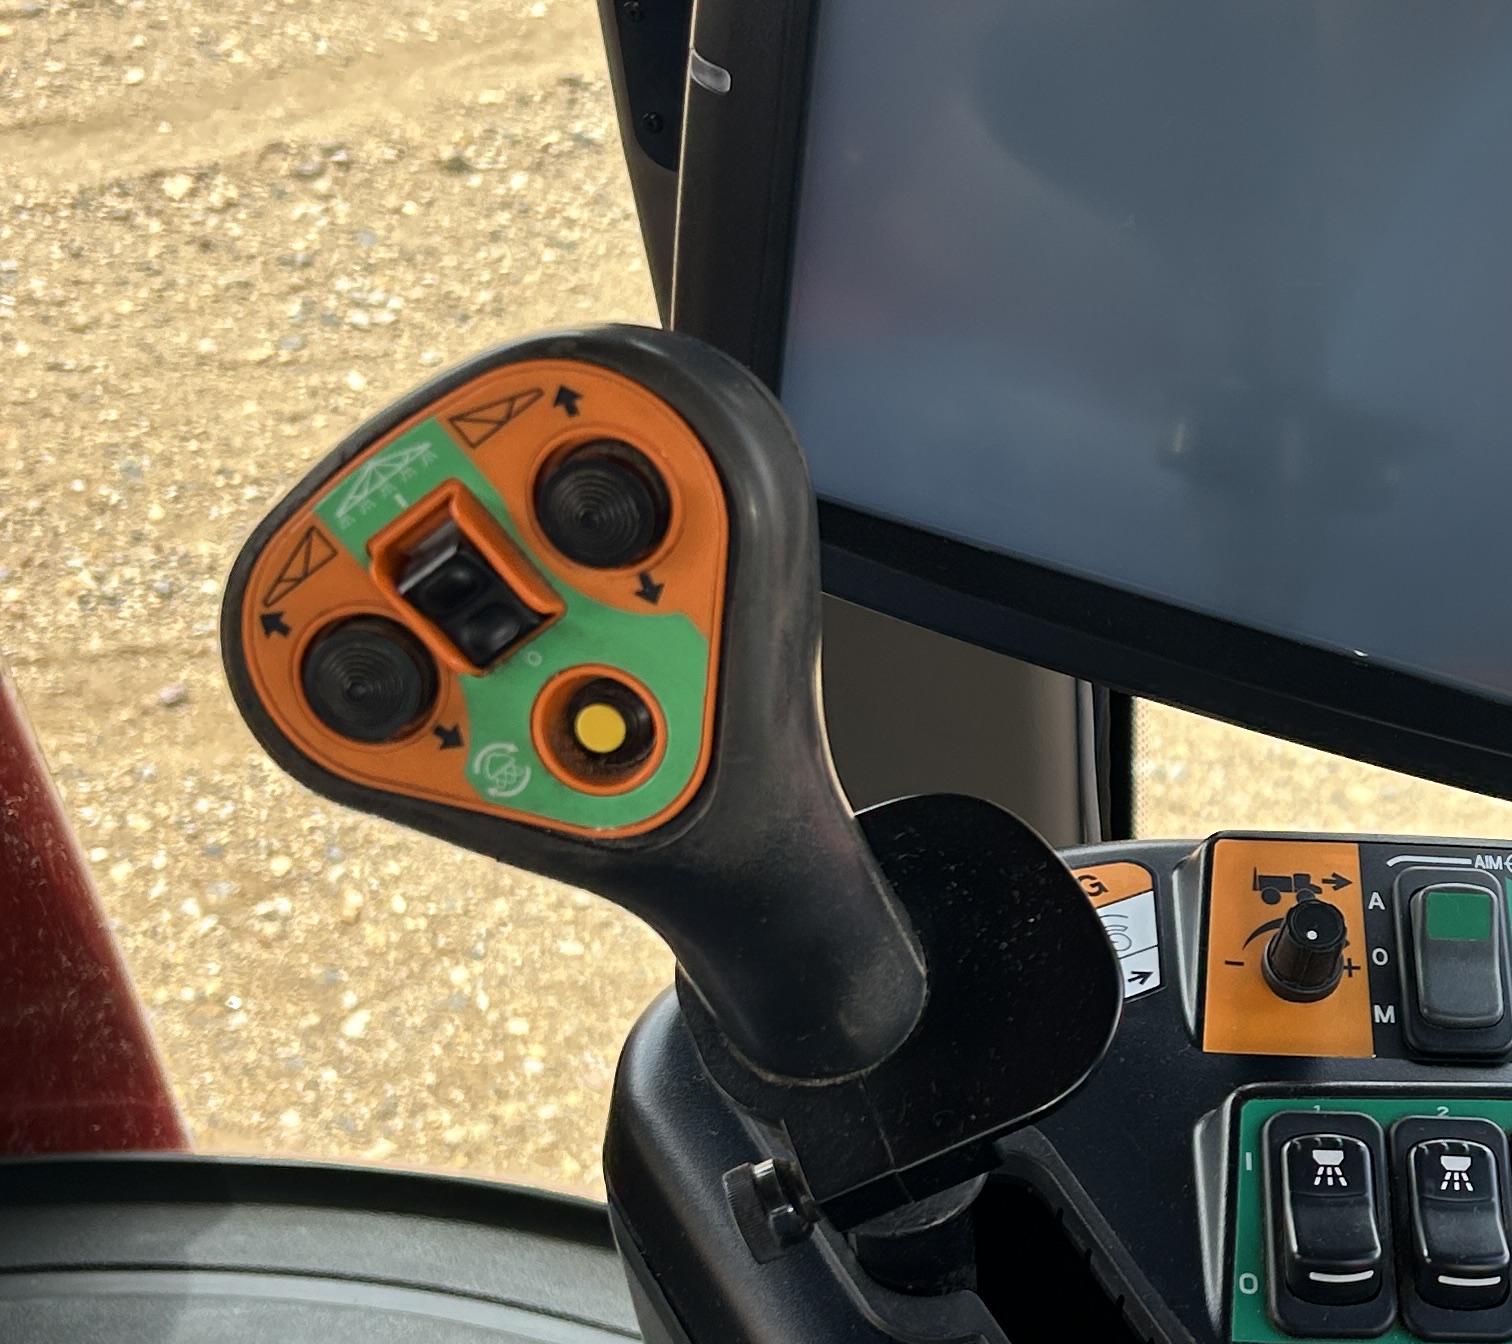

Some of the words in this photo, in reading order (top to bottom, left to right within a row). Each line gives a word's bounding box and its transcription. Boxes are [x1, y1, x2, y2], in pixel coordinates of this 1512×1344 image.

[1474, 854, 1503, 871] AIM
[1368, 892, 1386, 910] A
[1374, 1004, 1396, 1024] M
[1437, 1106, 1450, 1117] 2
